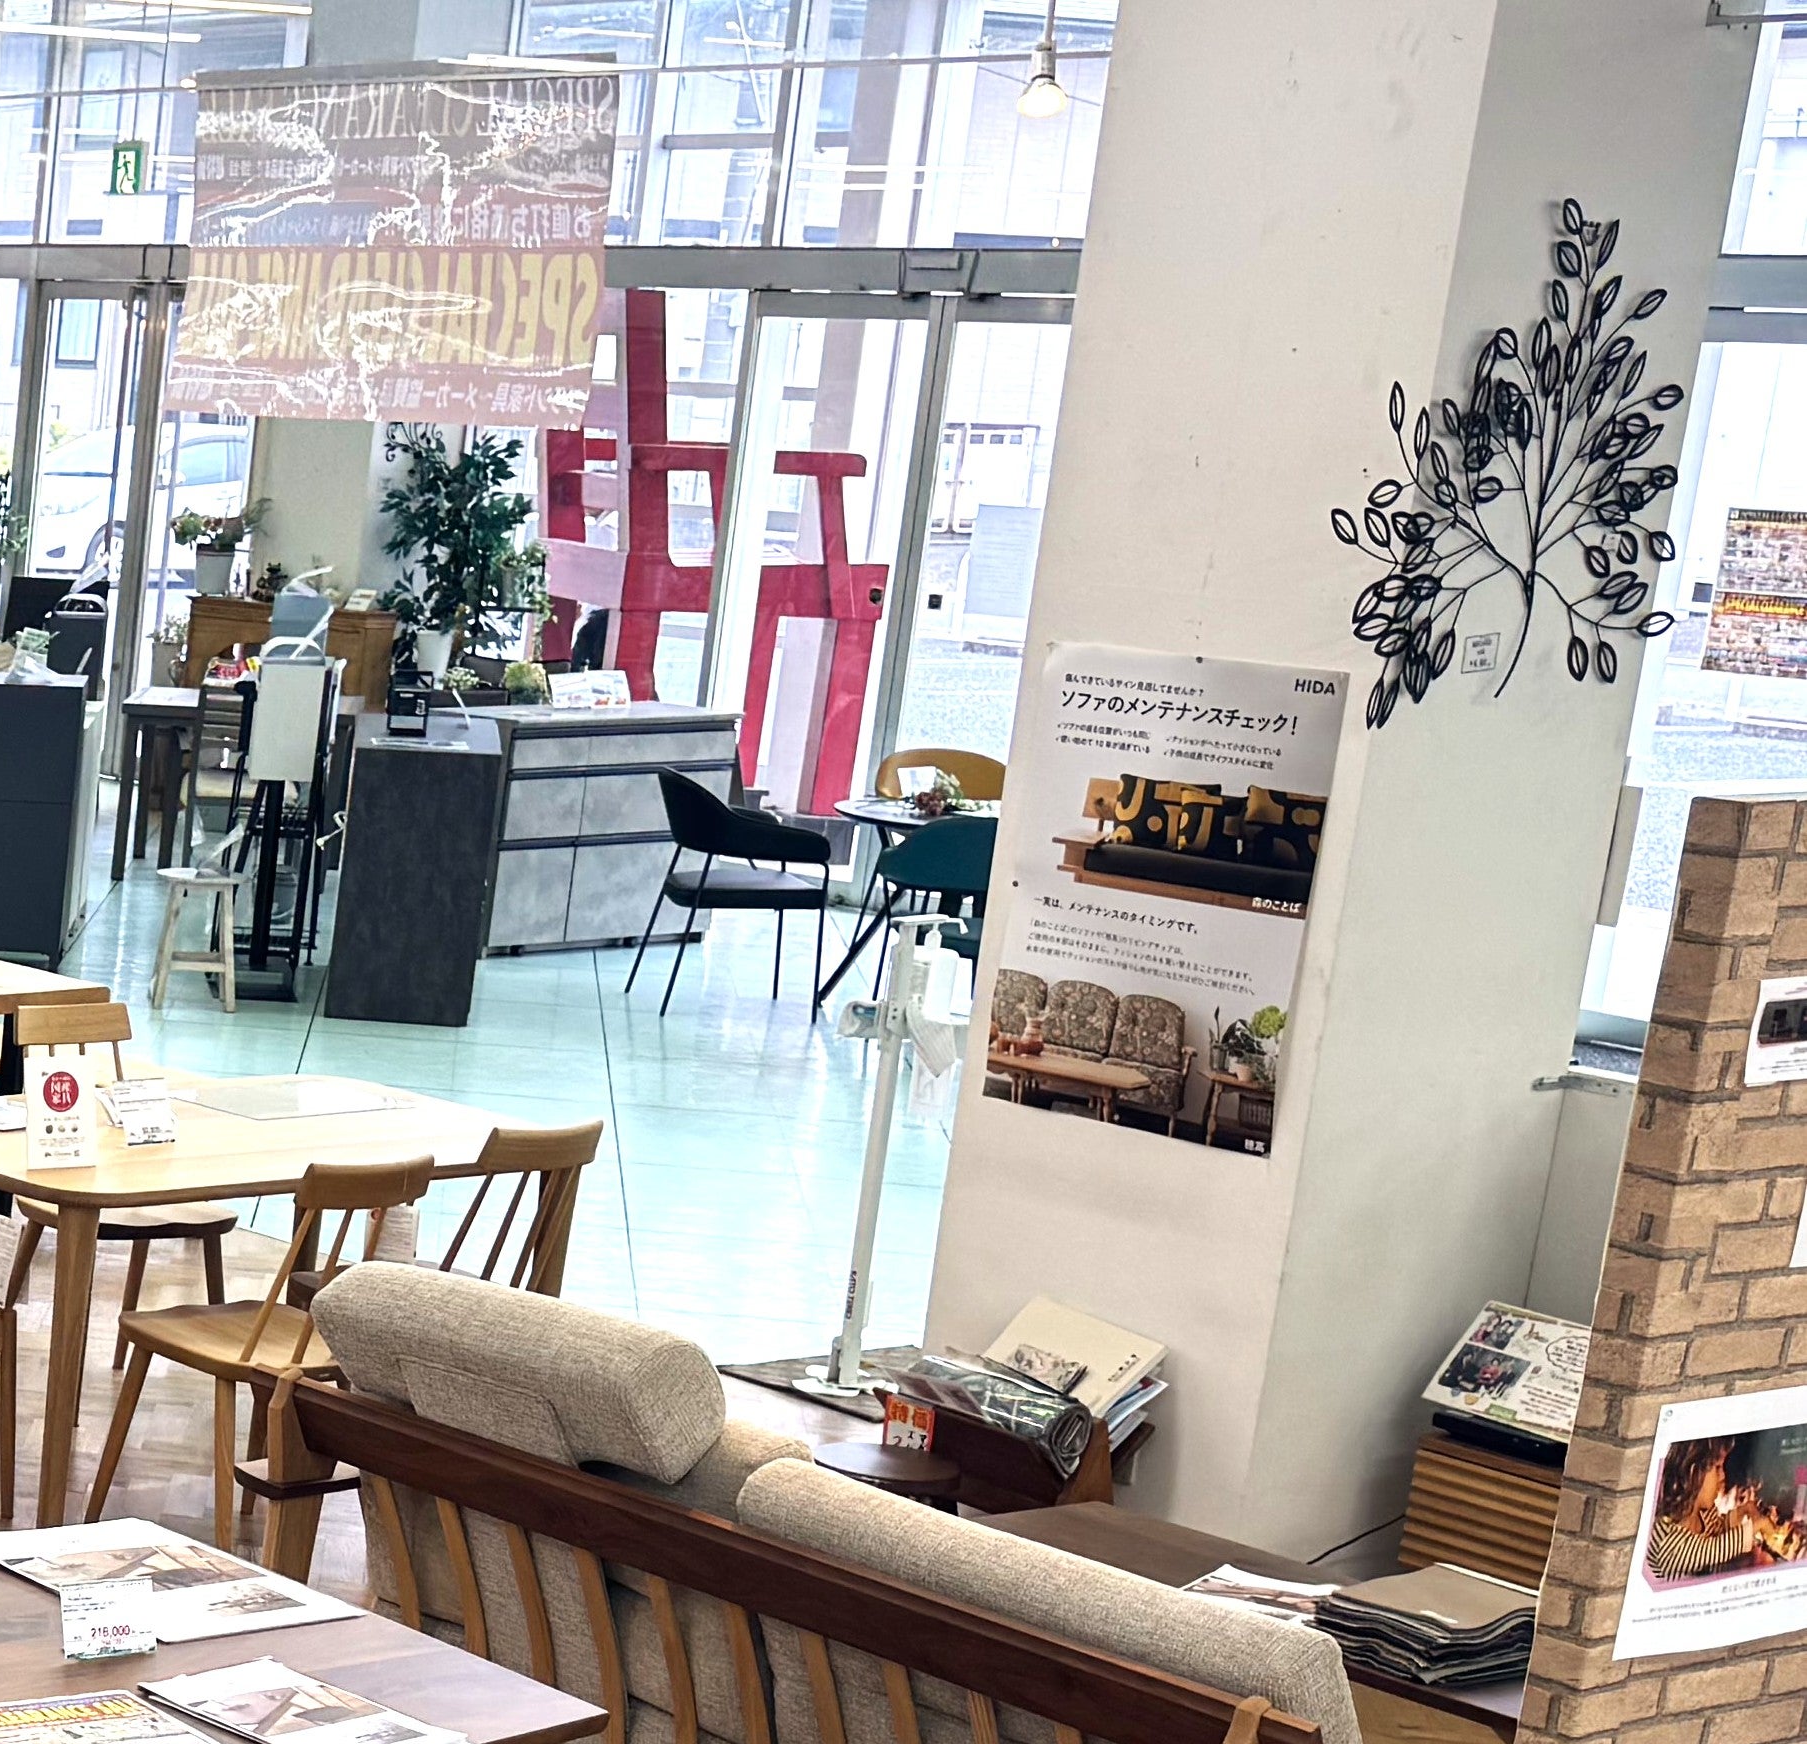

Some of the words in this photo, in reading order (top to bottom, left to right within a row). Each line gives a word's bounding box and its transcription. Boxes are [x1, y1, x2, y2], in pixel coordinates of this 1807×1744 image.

[1294, 678, 1336, 696] HIDA
[1061, 690, 1298, 735] ソファのメンテナンスチェック！
